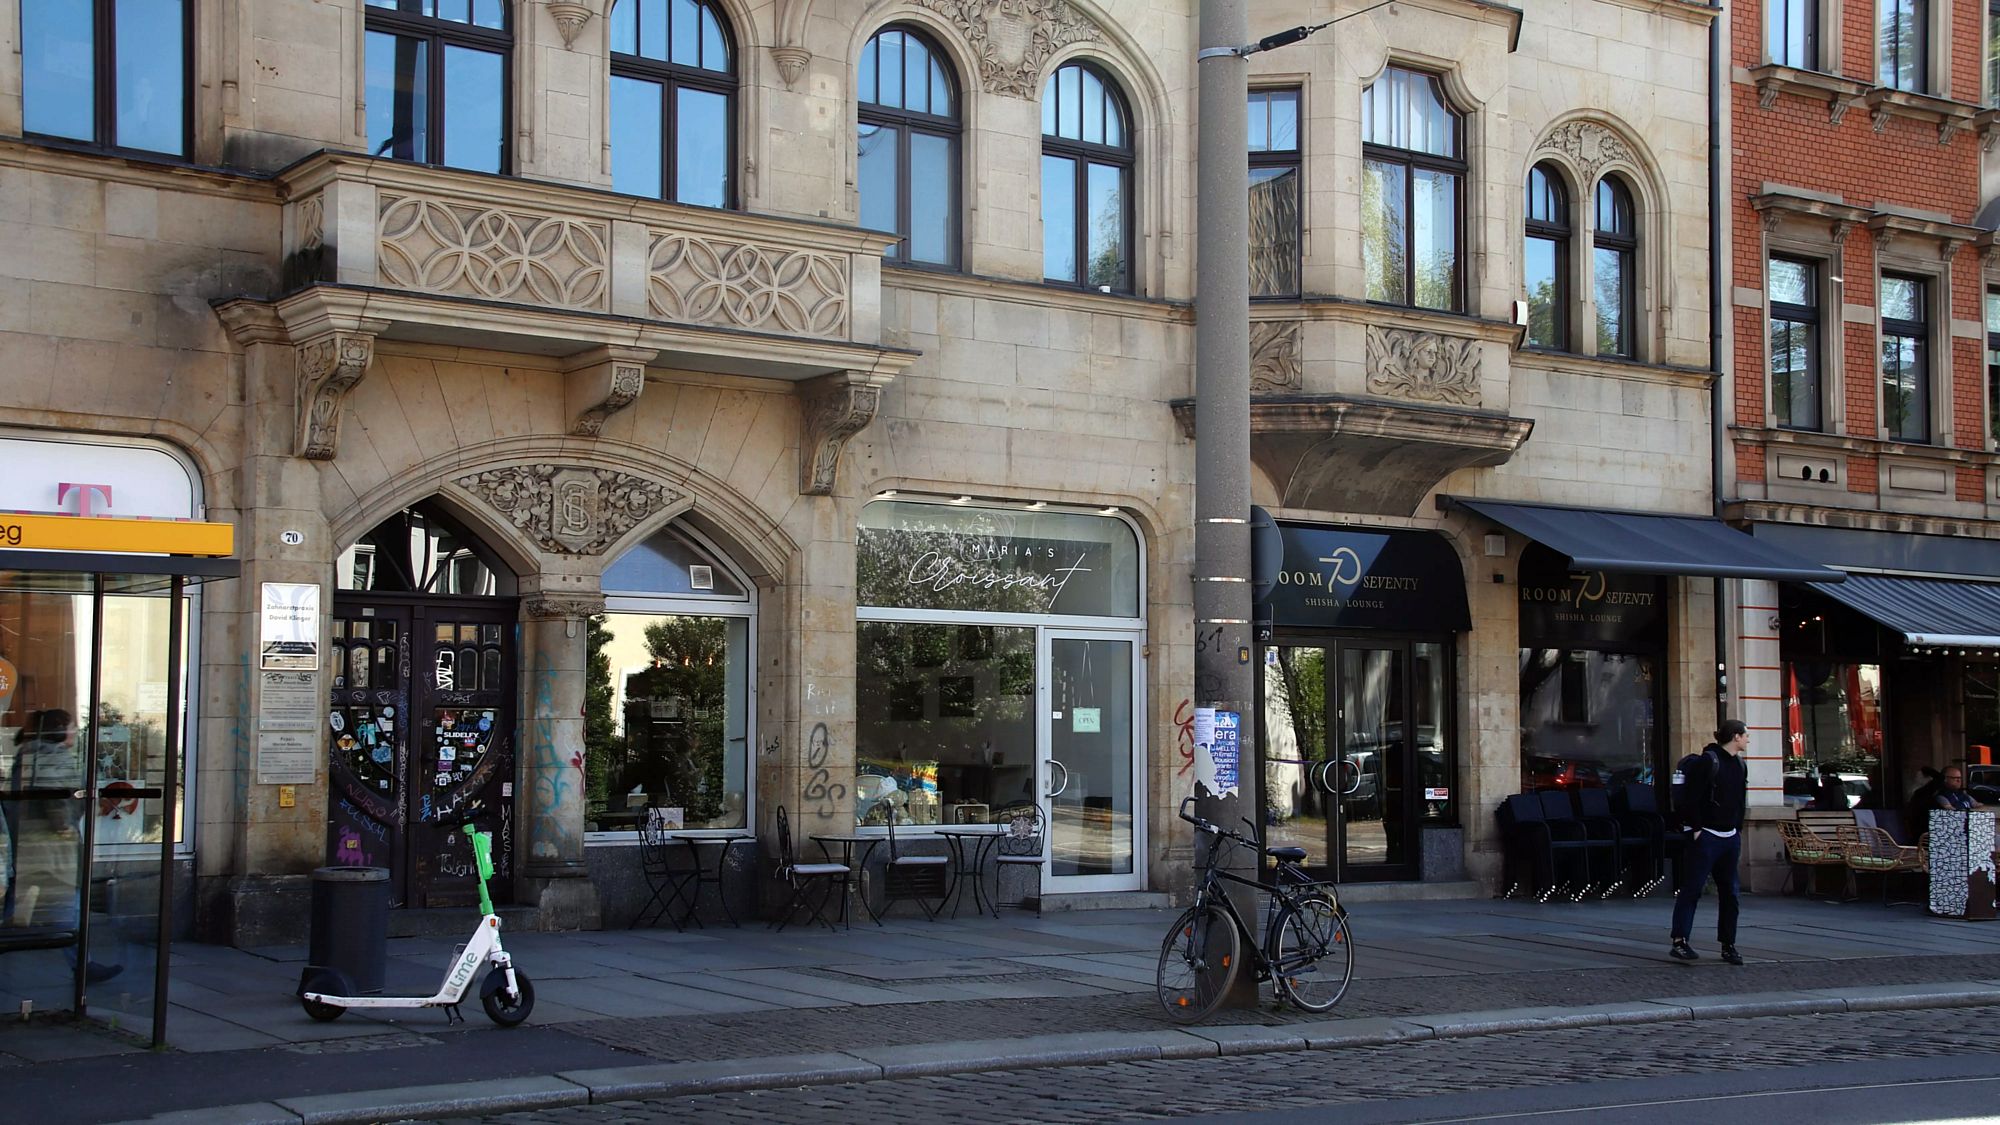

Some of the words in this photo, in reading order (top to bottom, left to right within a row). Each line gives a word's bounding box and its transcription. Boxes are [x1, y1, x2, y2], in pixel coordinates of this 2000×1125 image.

[58, 482, 112, 518] T
[285, 532, 299, 544] 70
[972, 544, 1055, 558] MARIA'S
[908, 550, 1092, 609] Croissant
[1278, 571, 1323, 586] OOM
[1363, 575, 1419, 591] SEVENTY
[1522, 587, 1572, 602] ROOM
[1605, 591, 1654, 605] SEVENTY
[1304, 597, 1340, 607] SHISHA
[1347, 599, 1385, 609] LOUNGE
[269, 614, 288, 622] David
[1554, 612, 1585, 622] SHISHA
[1590, 614, 1622, 623] LOUNGE
[1215, 730, 1236, 740] era
